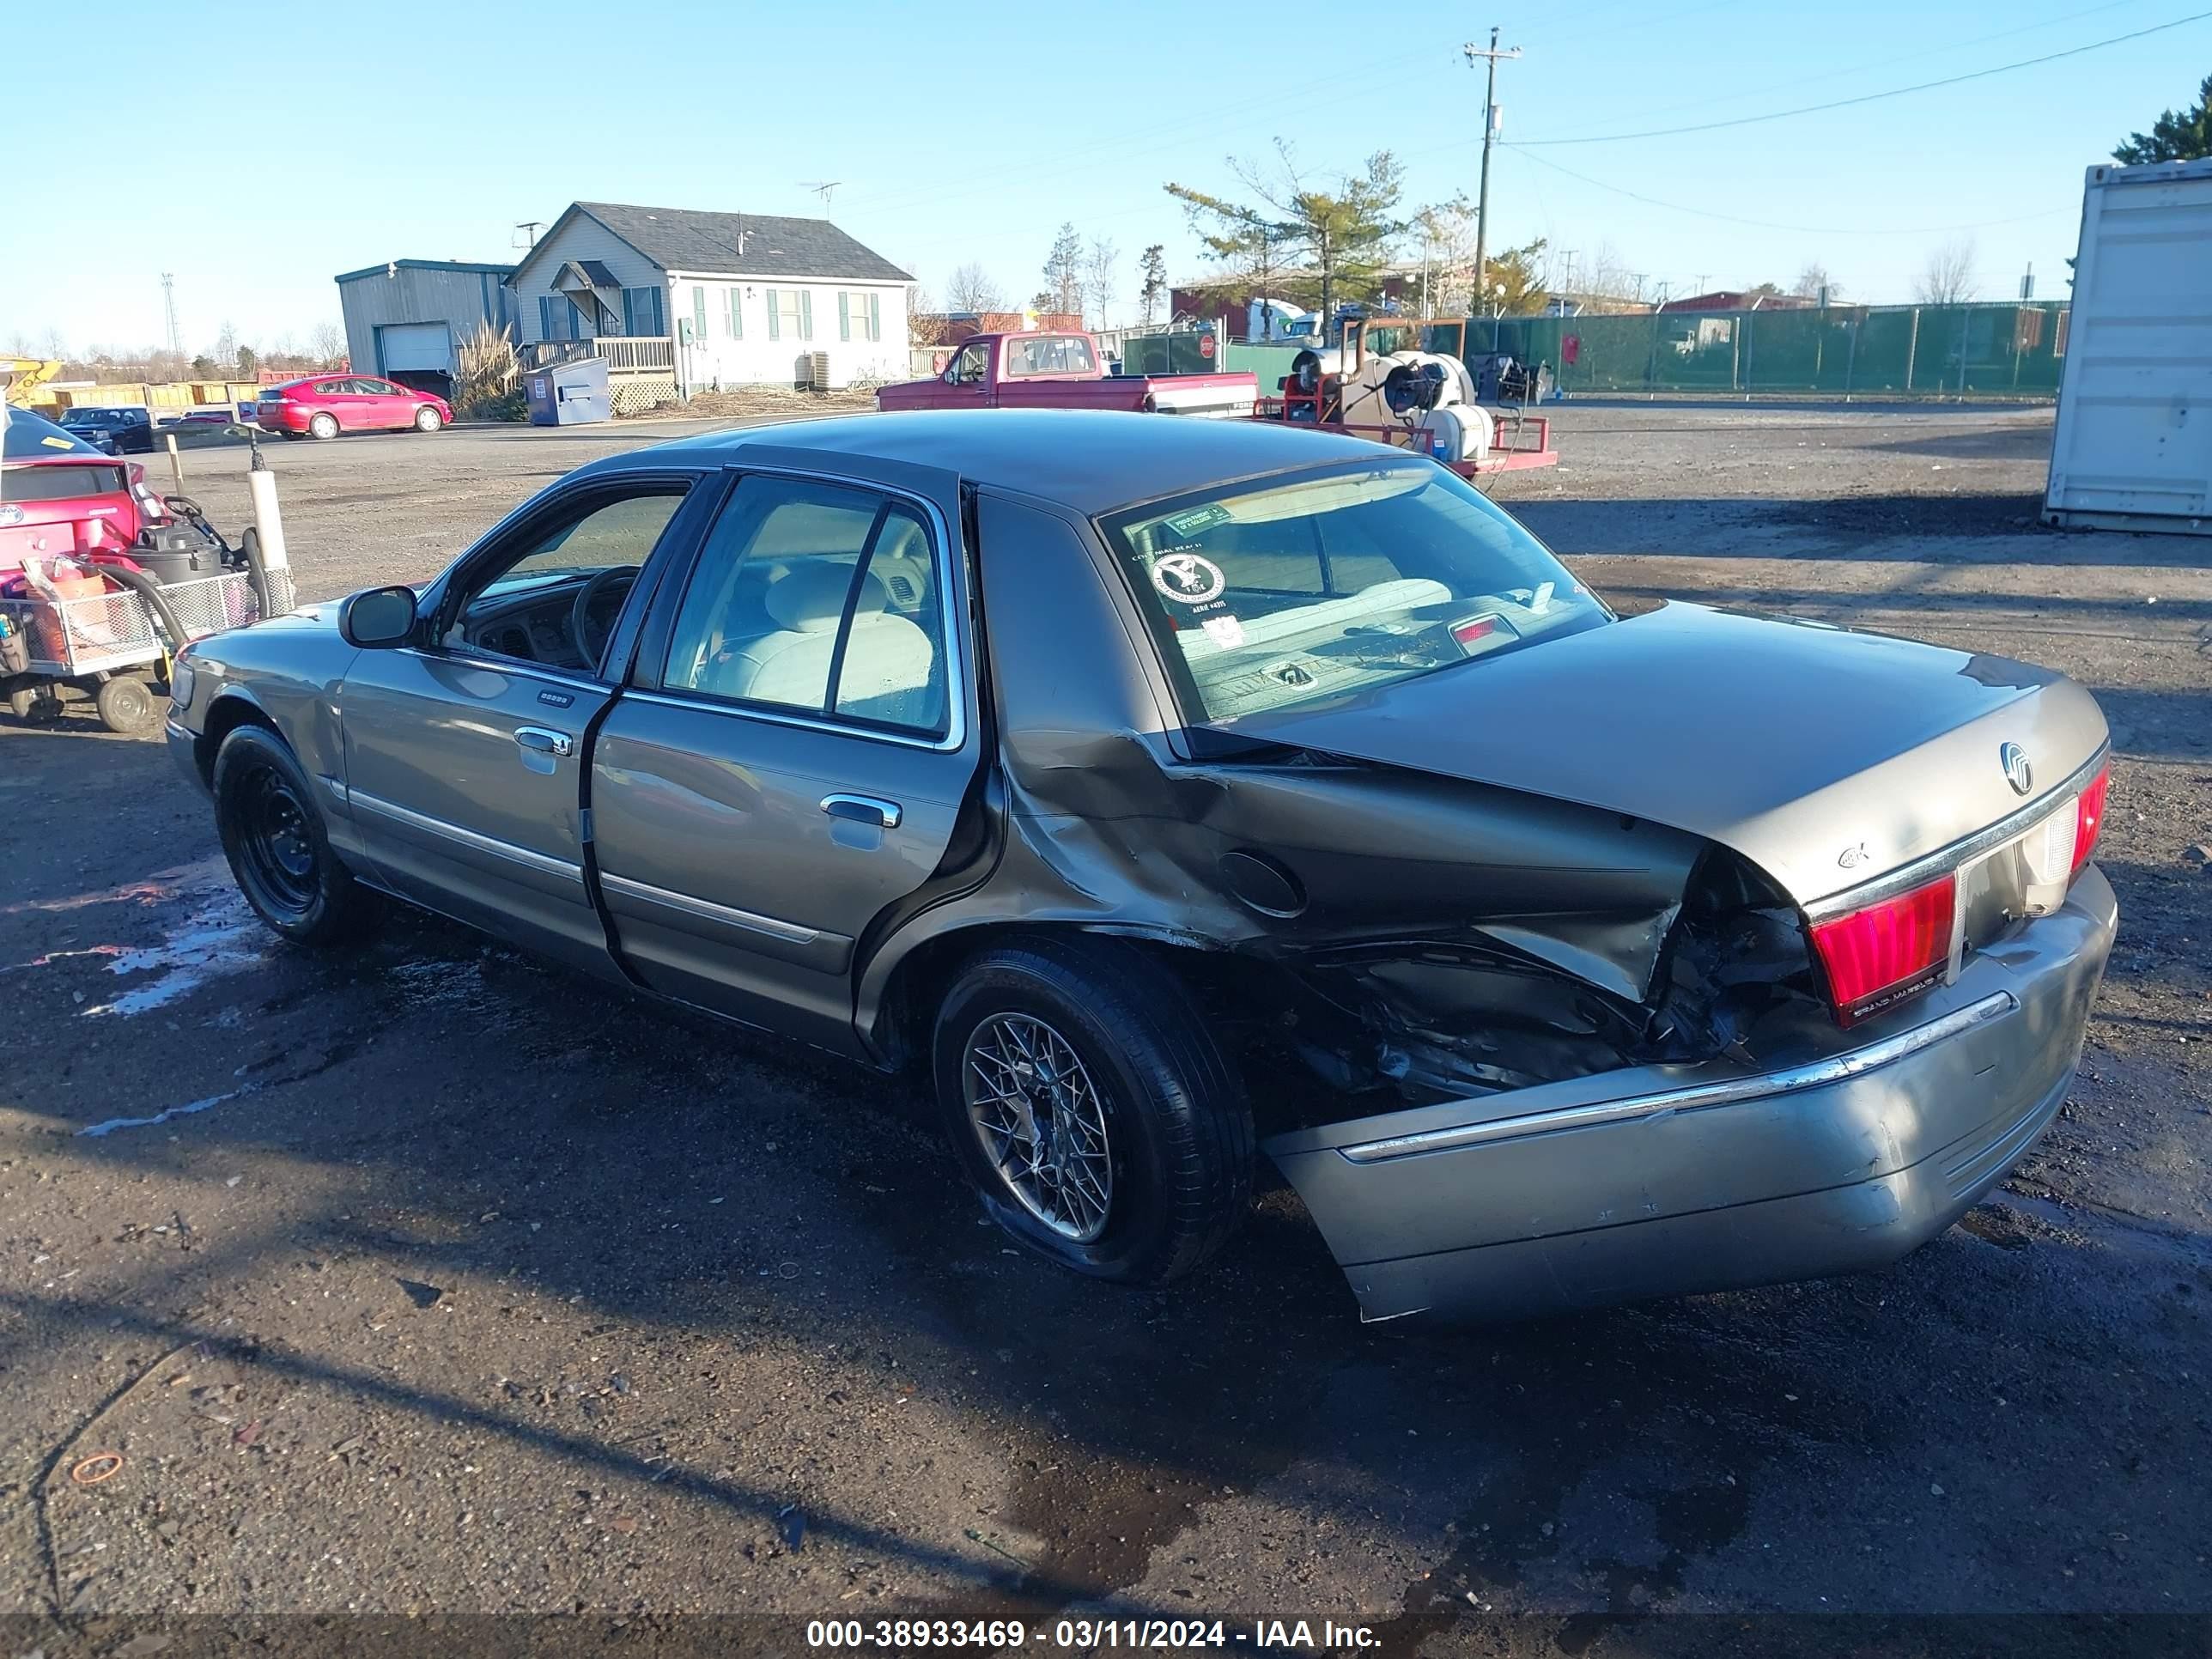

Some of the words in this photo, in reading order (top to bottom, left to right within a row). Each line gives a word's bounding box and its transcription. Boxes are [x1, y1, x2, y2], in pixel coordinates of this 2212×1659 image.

[1201, 342, 1214, 352] STOP
[1176, 517, 1191, 526] PROUD
[1191, 511, 1210, 520] PARENT
[1191, 515, 1212, 525] SOLDIER
[1132, 548, 1174, 562] COLNIAL
[1176, 542, 1203, 552] BEACH
[1154, 576, 1189, 600] FRATERNAL
[1193, 604, 1210, 613] AERIE
[1854, 997, 1890, 1018] GRAND
